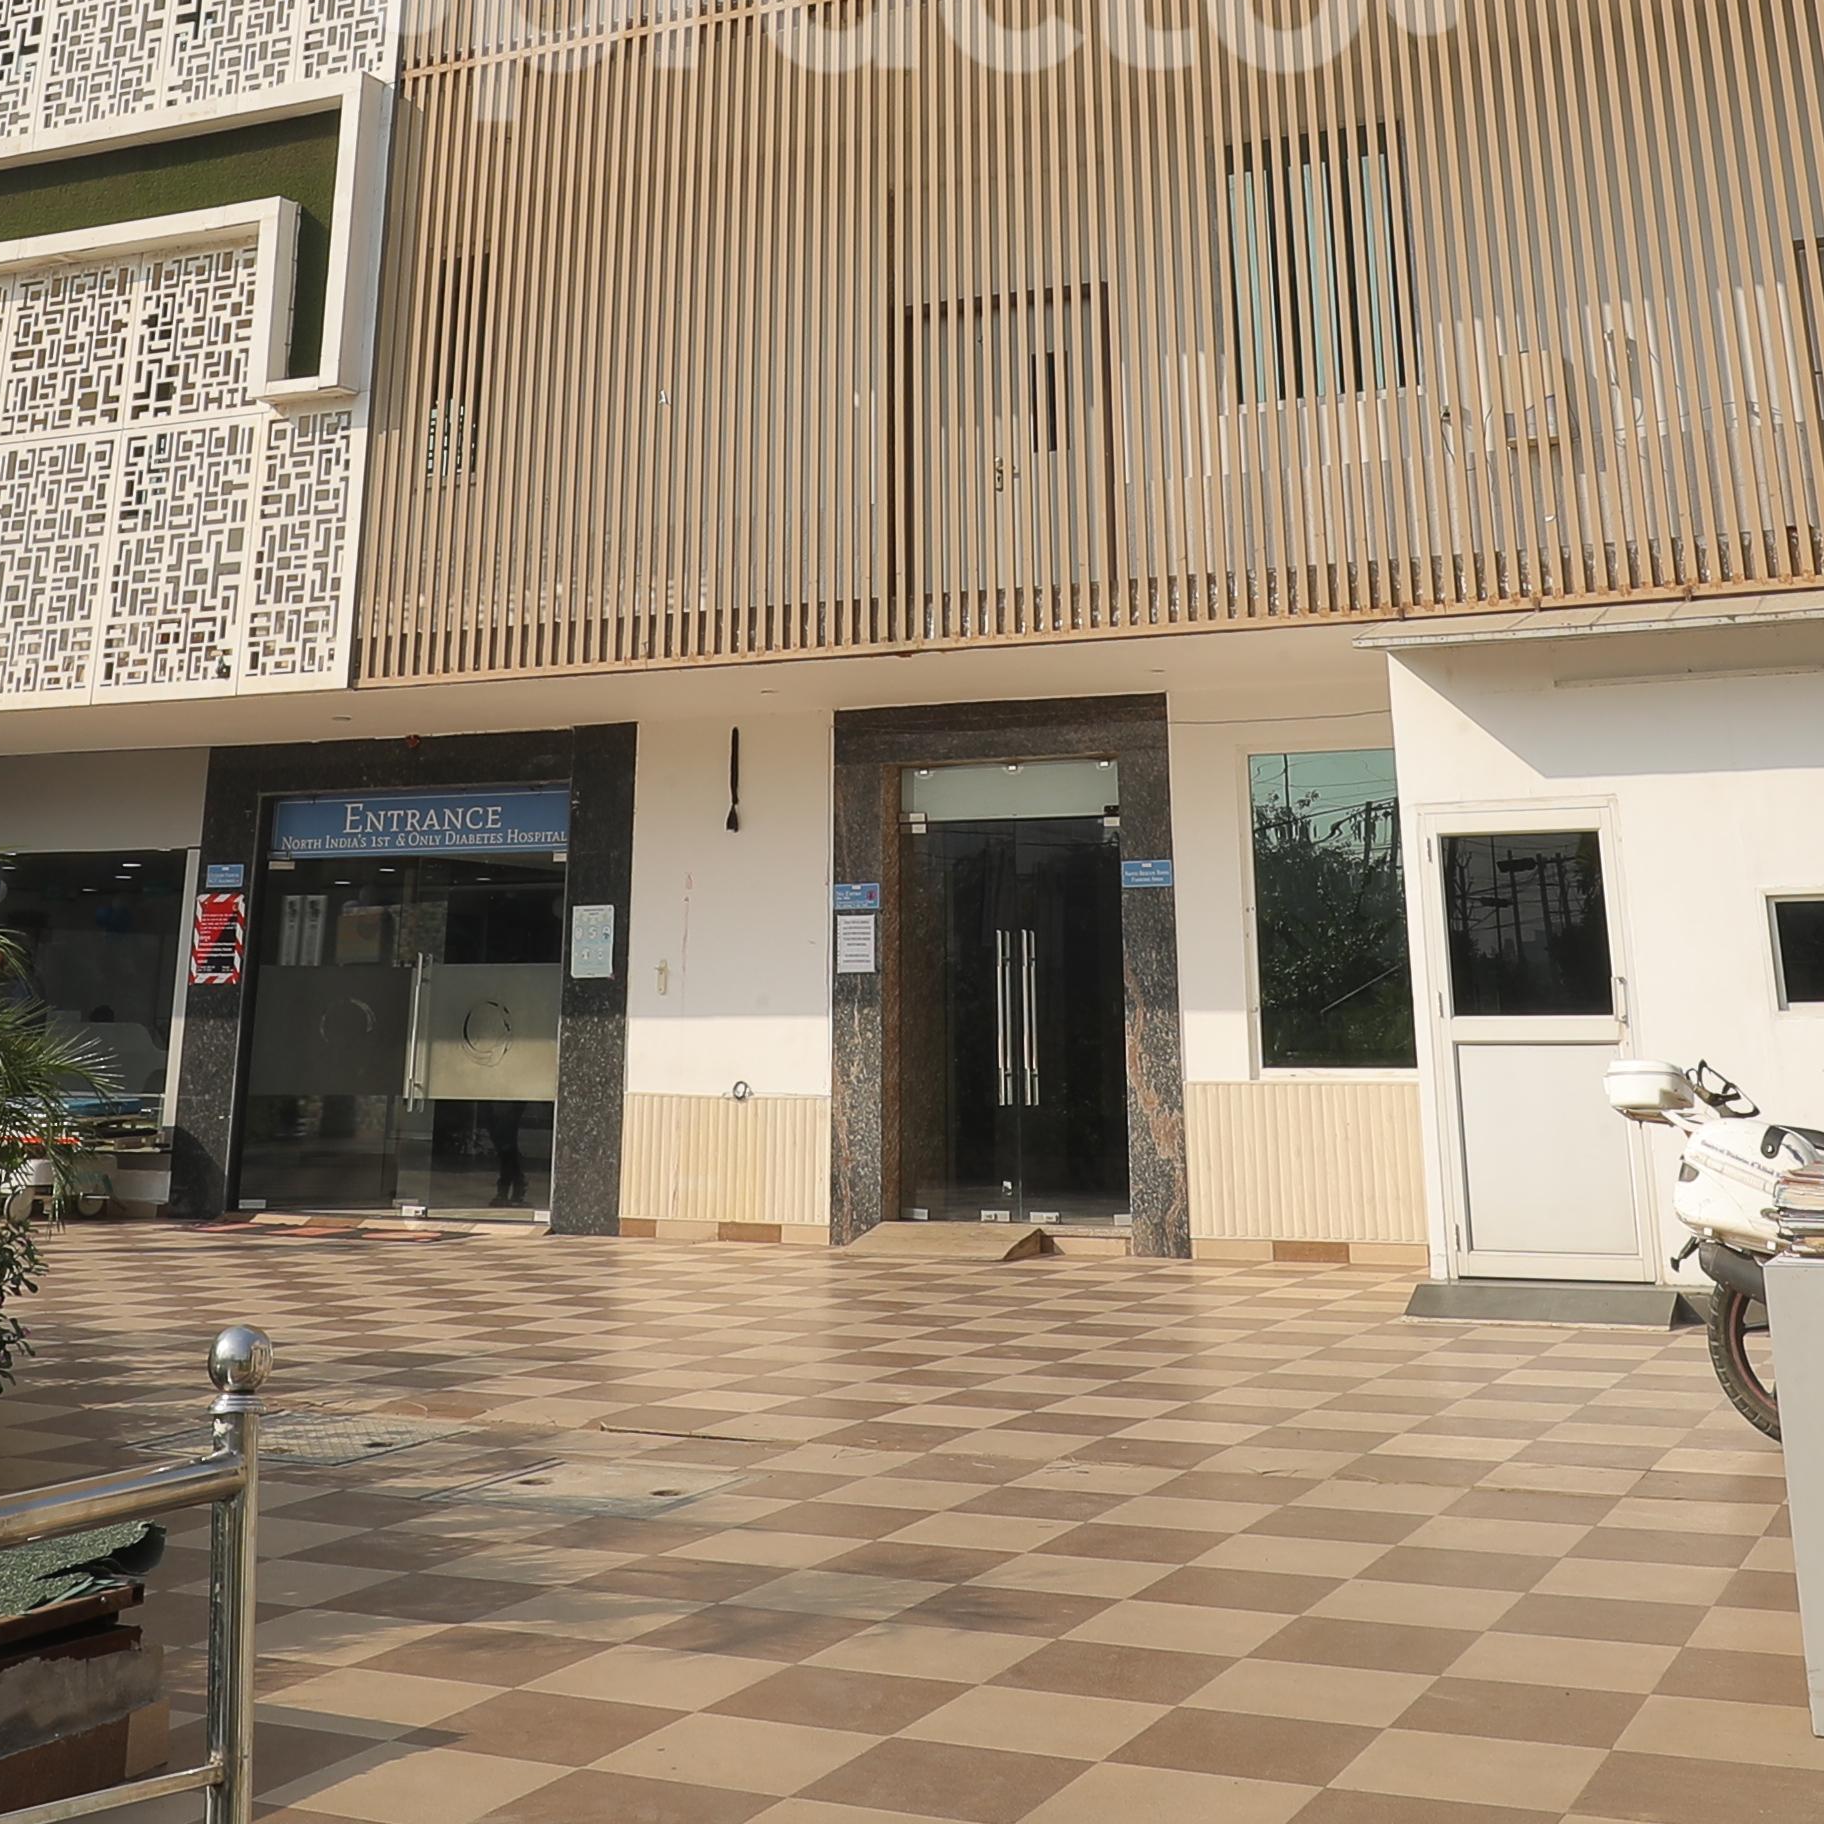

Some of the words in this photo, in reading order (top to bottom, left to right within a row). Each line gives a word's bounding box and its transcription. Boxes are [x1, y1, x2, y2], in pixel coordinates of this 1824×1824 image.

[342, 803, 503, 834] ENTRANCE
[281, 835, 322, 851] NORTH
[370, 834, 391, 848] 1ST
[395, 833, 407, 847] &
[407, 832, 442, 847] ONLY
[444, 831, 504, 846] DIABETES
[506, 828, 568, 844] HOSPITAL
